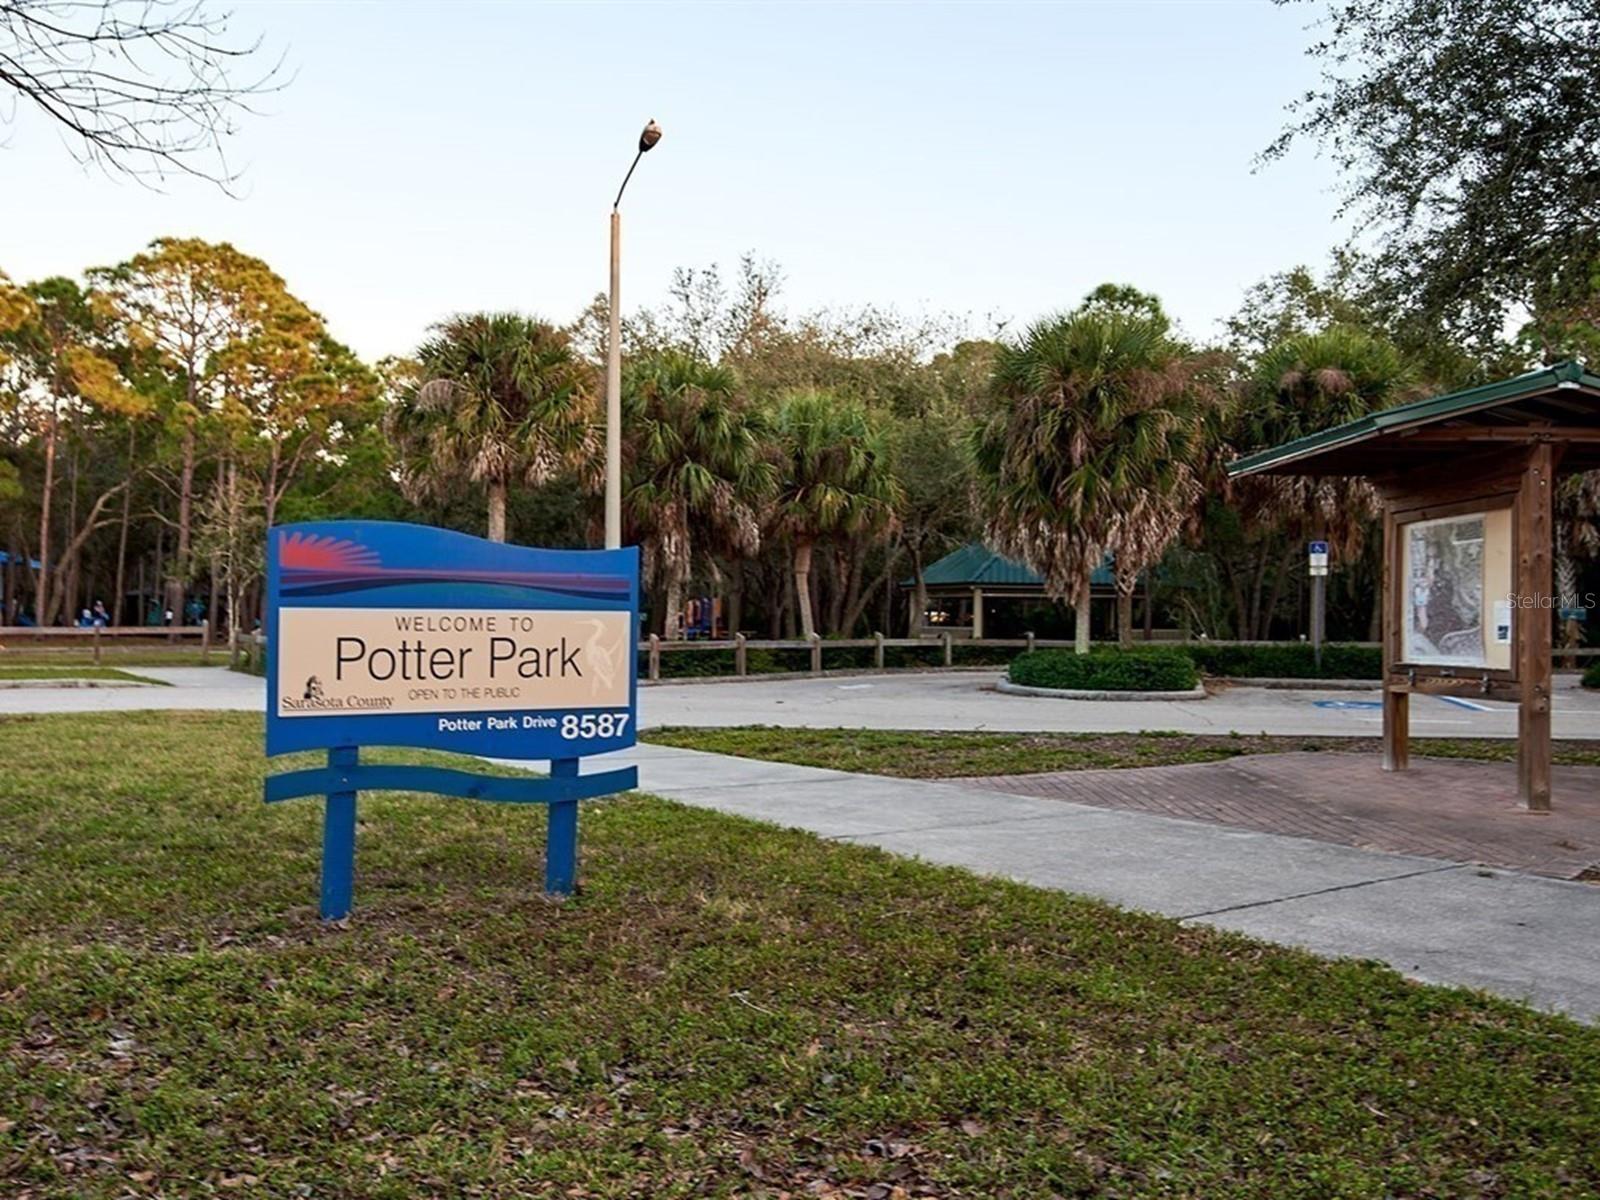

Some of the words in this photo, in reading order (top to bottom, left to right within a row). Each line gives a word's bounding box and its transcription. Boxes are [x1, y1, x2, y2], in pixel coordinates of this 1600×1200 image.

[395, 616, 498, 632] WELCOME
[509, 616, 534, 632] TO
[335, 637, 472, 681] Potter
[489, 637, 583, 679] Park
[282, 695, 345, 709] Sarasota
[346, 695, 395, 709] County
[408, 688, 441, 701] OPEN
[442, 688, 458, 700] TO
[460, 687, 481, 700] THE
[483, 687, 521, 699] PUBLIC
[438, 718, 482, 732] Potter
[487, 716, 518, 730] Park
[523, 715, 557, 729] Drive
[560, 713, 630, 740] 8587
